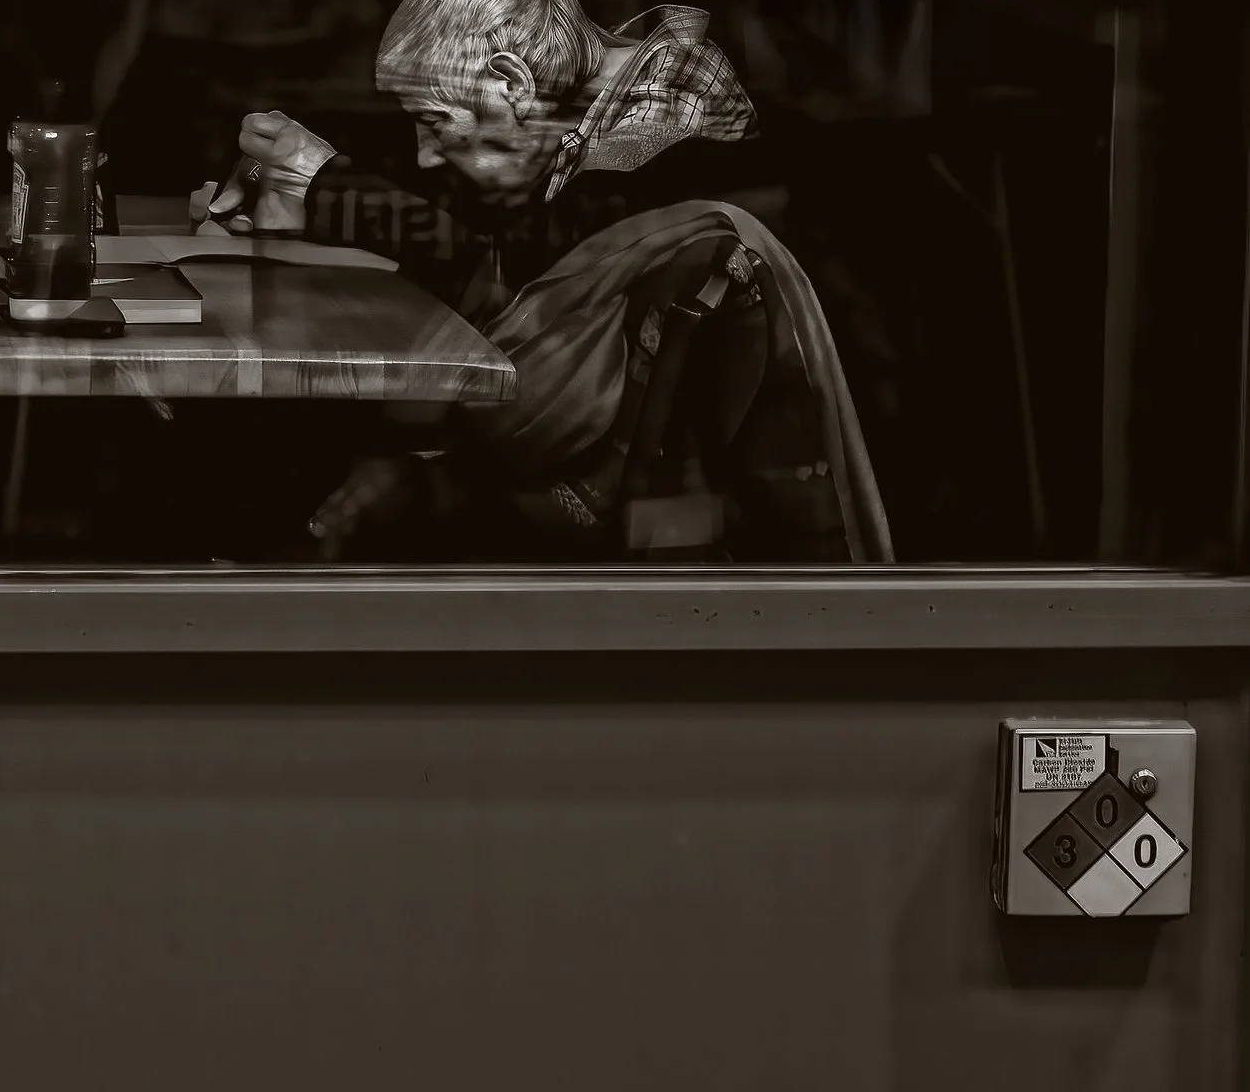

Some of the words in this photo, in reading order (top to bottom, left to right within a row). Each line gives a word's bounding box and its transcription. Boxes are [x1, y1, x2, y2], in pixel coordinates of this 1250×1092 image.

[1095, 794, 1119, 828] 0
[1053, 834, 1078, 868] 3
[1134, 834, 1158, 868] 0
